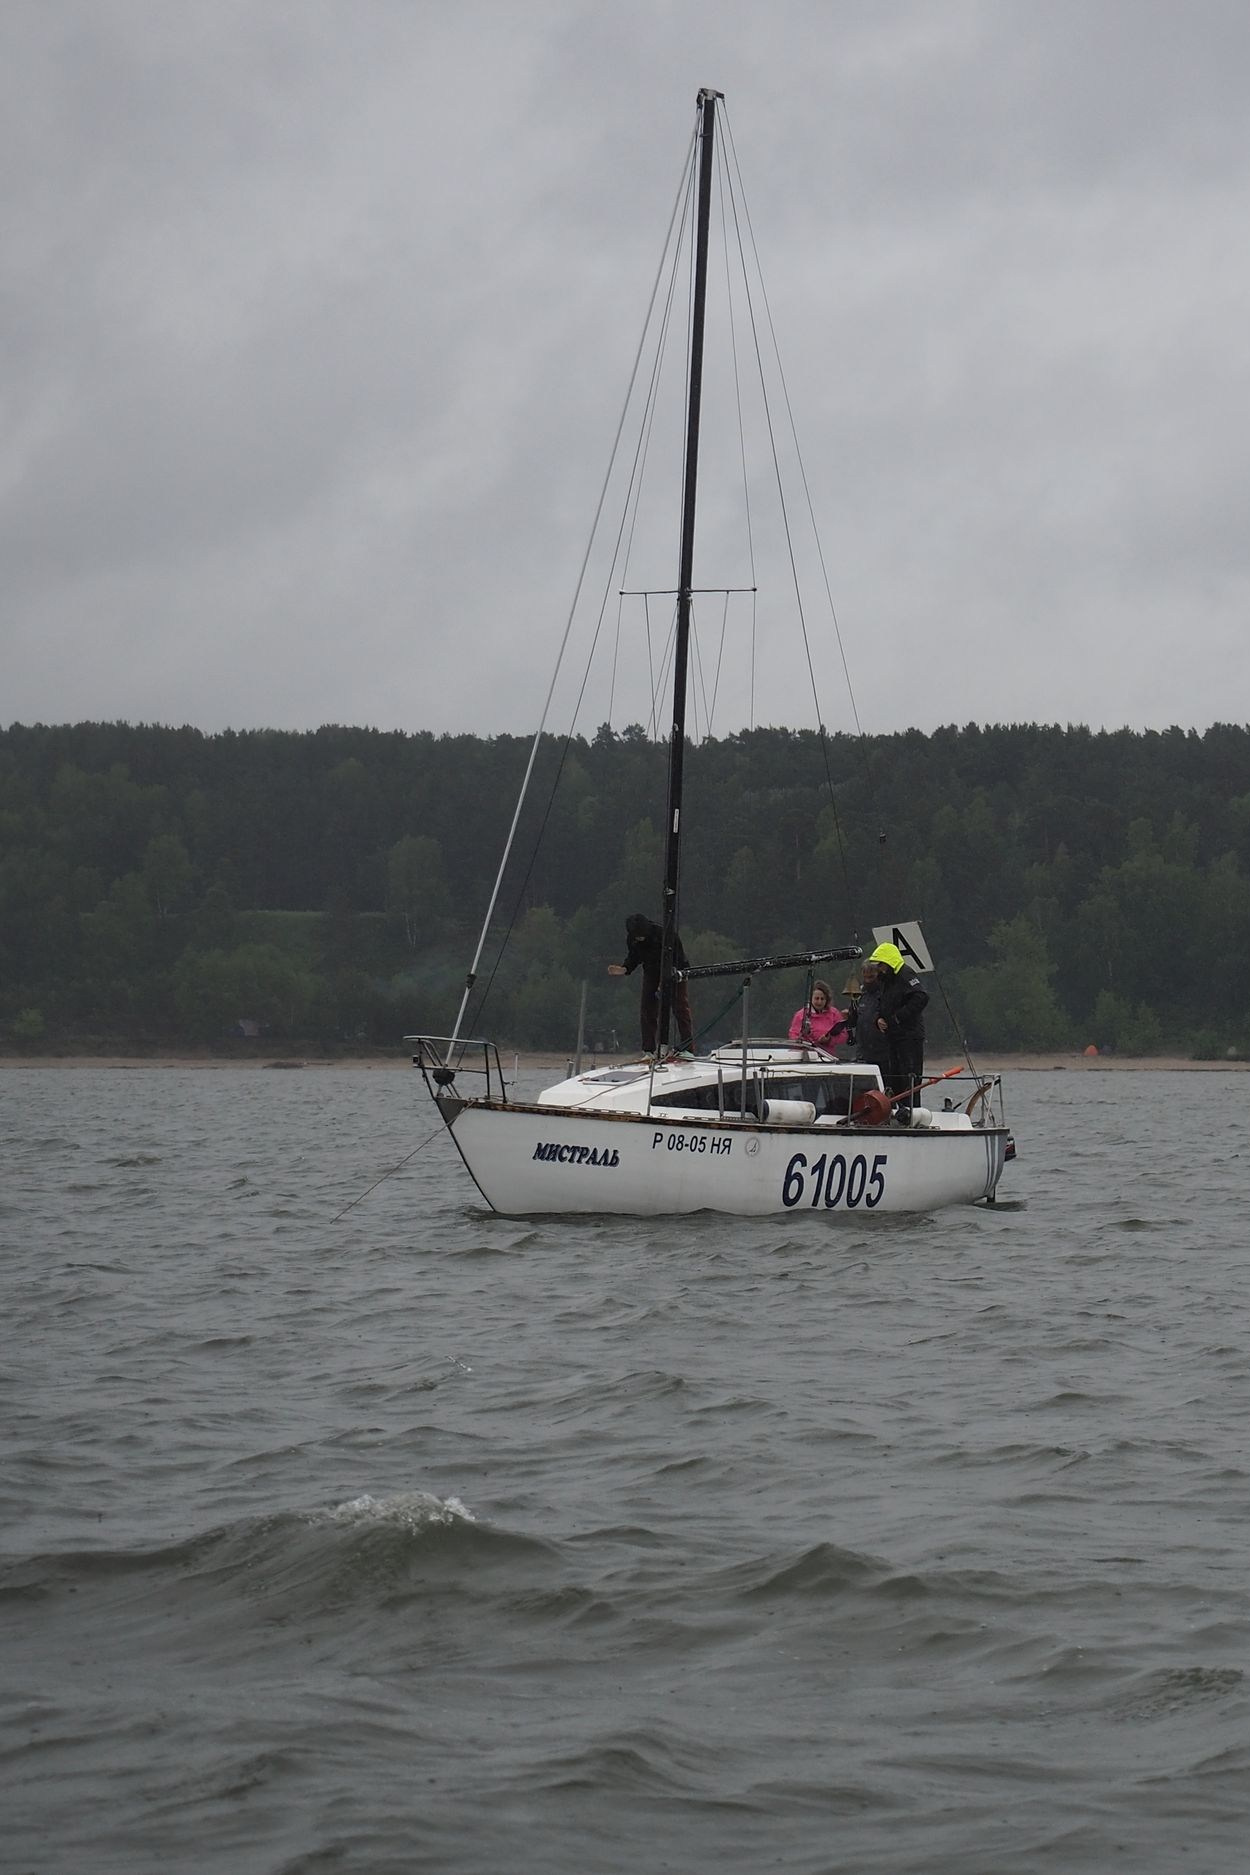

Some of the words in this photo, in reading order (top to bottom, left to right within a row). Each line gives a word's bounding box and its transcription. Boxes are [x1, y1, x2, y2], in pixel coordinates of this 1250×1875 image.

[533, 1141, 620, 1168] МИСТРАЛЬ
[667, 1133, 707, 1154] 08-05
[710, 1136, 733, 1156] НЯ
[782, 1152, 888, 1209] 61005
